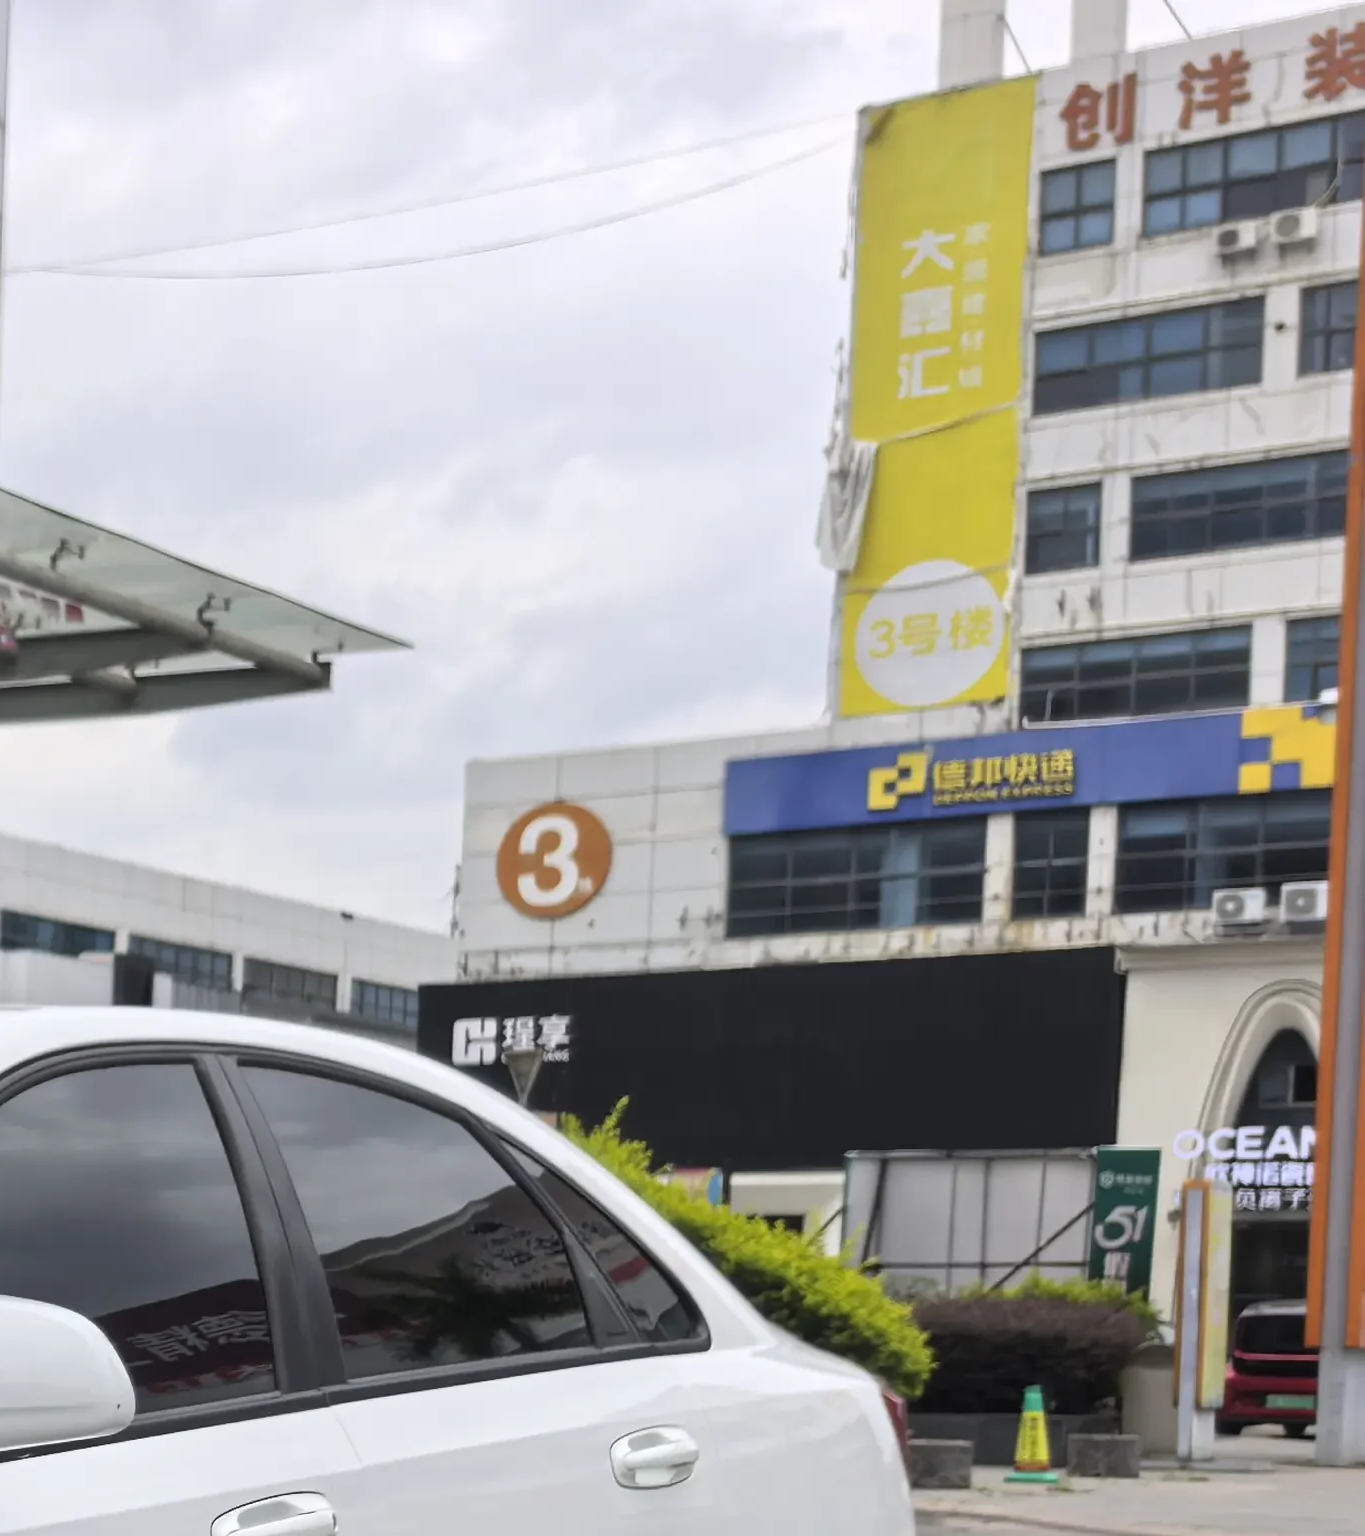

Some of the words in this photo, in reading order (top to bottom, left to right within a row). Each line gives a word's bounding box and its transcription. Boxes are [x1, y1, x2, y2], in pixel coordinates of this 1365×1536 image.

[869, 605, 994, 660] 3号楼
[933, 750, 1074, 790] 德邦快递
[517, 815, 579, 907] 3
[1235, 1187, 1315, 1211] 负离子
